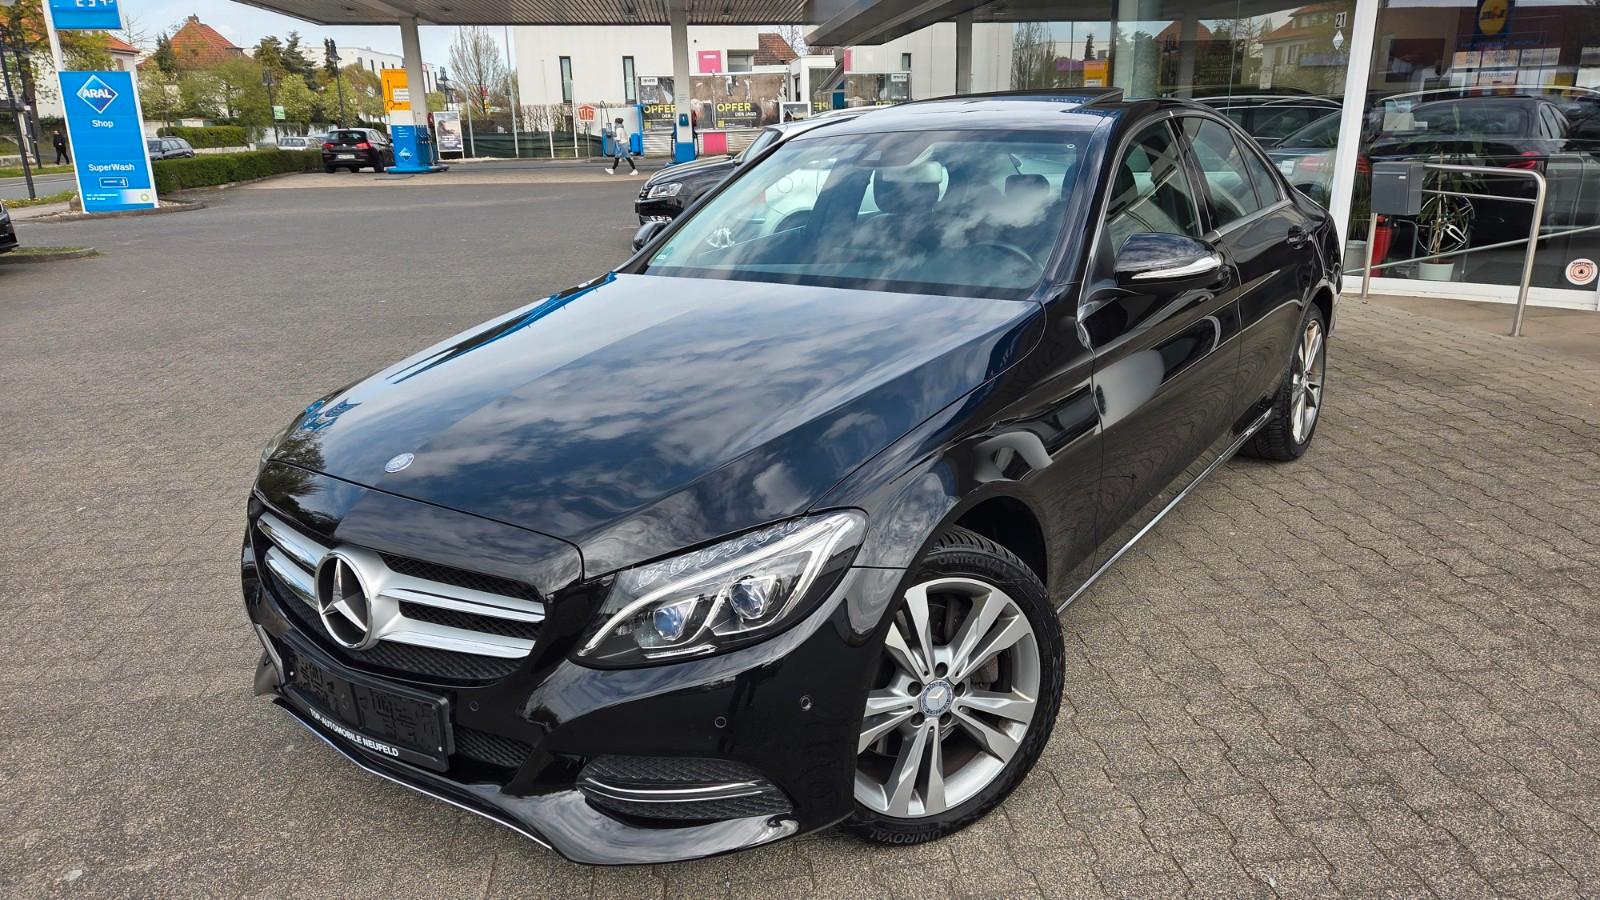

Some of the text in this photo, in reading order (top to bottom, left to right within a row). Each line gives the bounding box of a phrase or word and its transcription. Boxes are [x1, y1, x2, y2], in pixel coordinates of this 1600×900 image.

[1336, 13, 1345, 27] 21
[82, 89, 113, 99] ARAL
[643, 104, 677, 114] OPFER
[717, 103, 751, 112] OPFER
[91, 120, 114, 128] Shop
[88, 163, 135, 172] SuperWash
[309, 707, 399, 757] TOP-AUTOMOBILE NEUFELD
